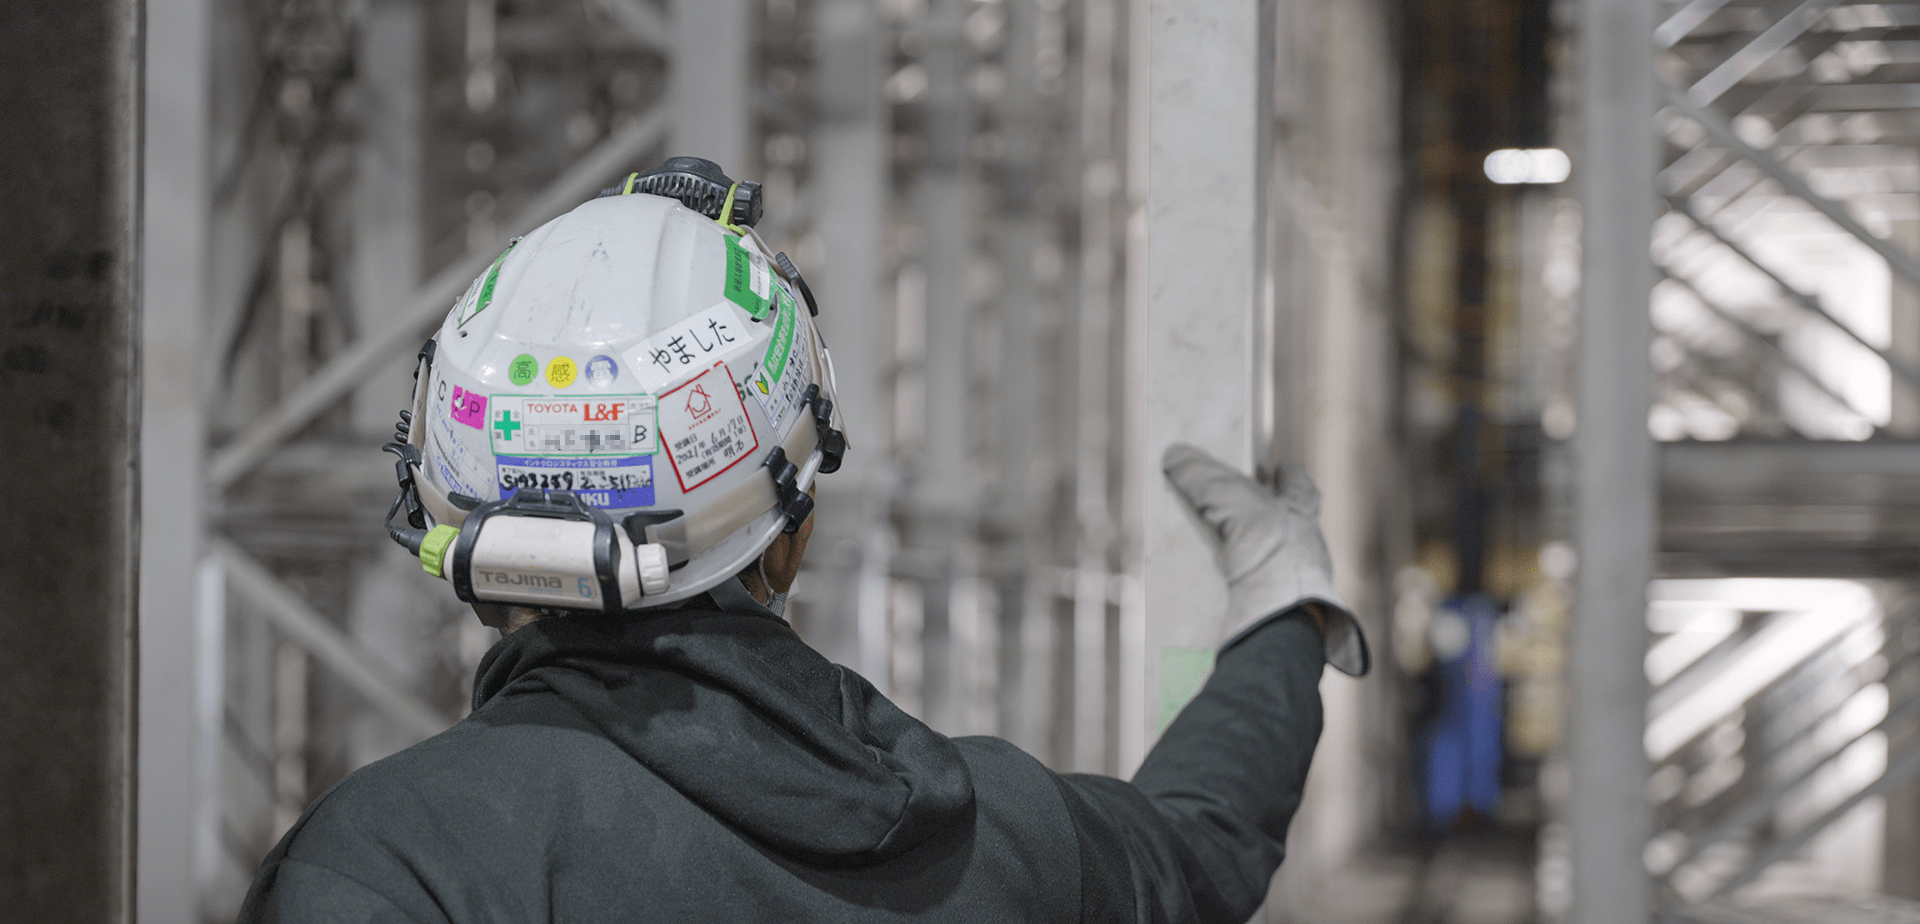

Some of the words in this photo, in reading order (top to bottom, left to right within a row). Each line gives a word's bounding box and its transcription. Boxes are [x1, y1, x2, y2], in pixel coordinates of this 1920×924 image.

[648, 318, 735, 373] やました
[527, 403, 578, 413] TOYOTA
[584, 403, 625, 421] L&F
[632, 425, 647, 444] B
[577, 577, 593, 598] 6
